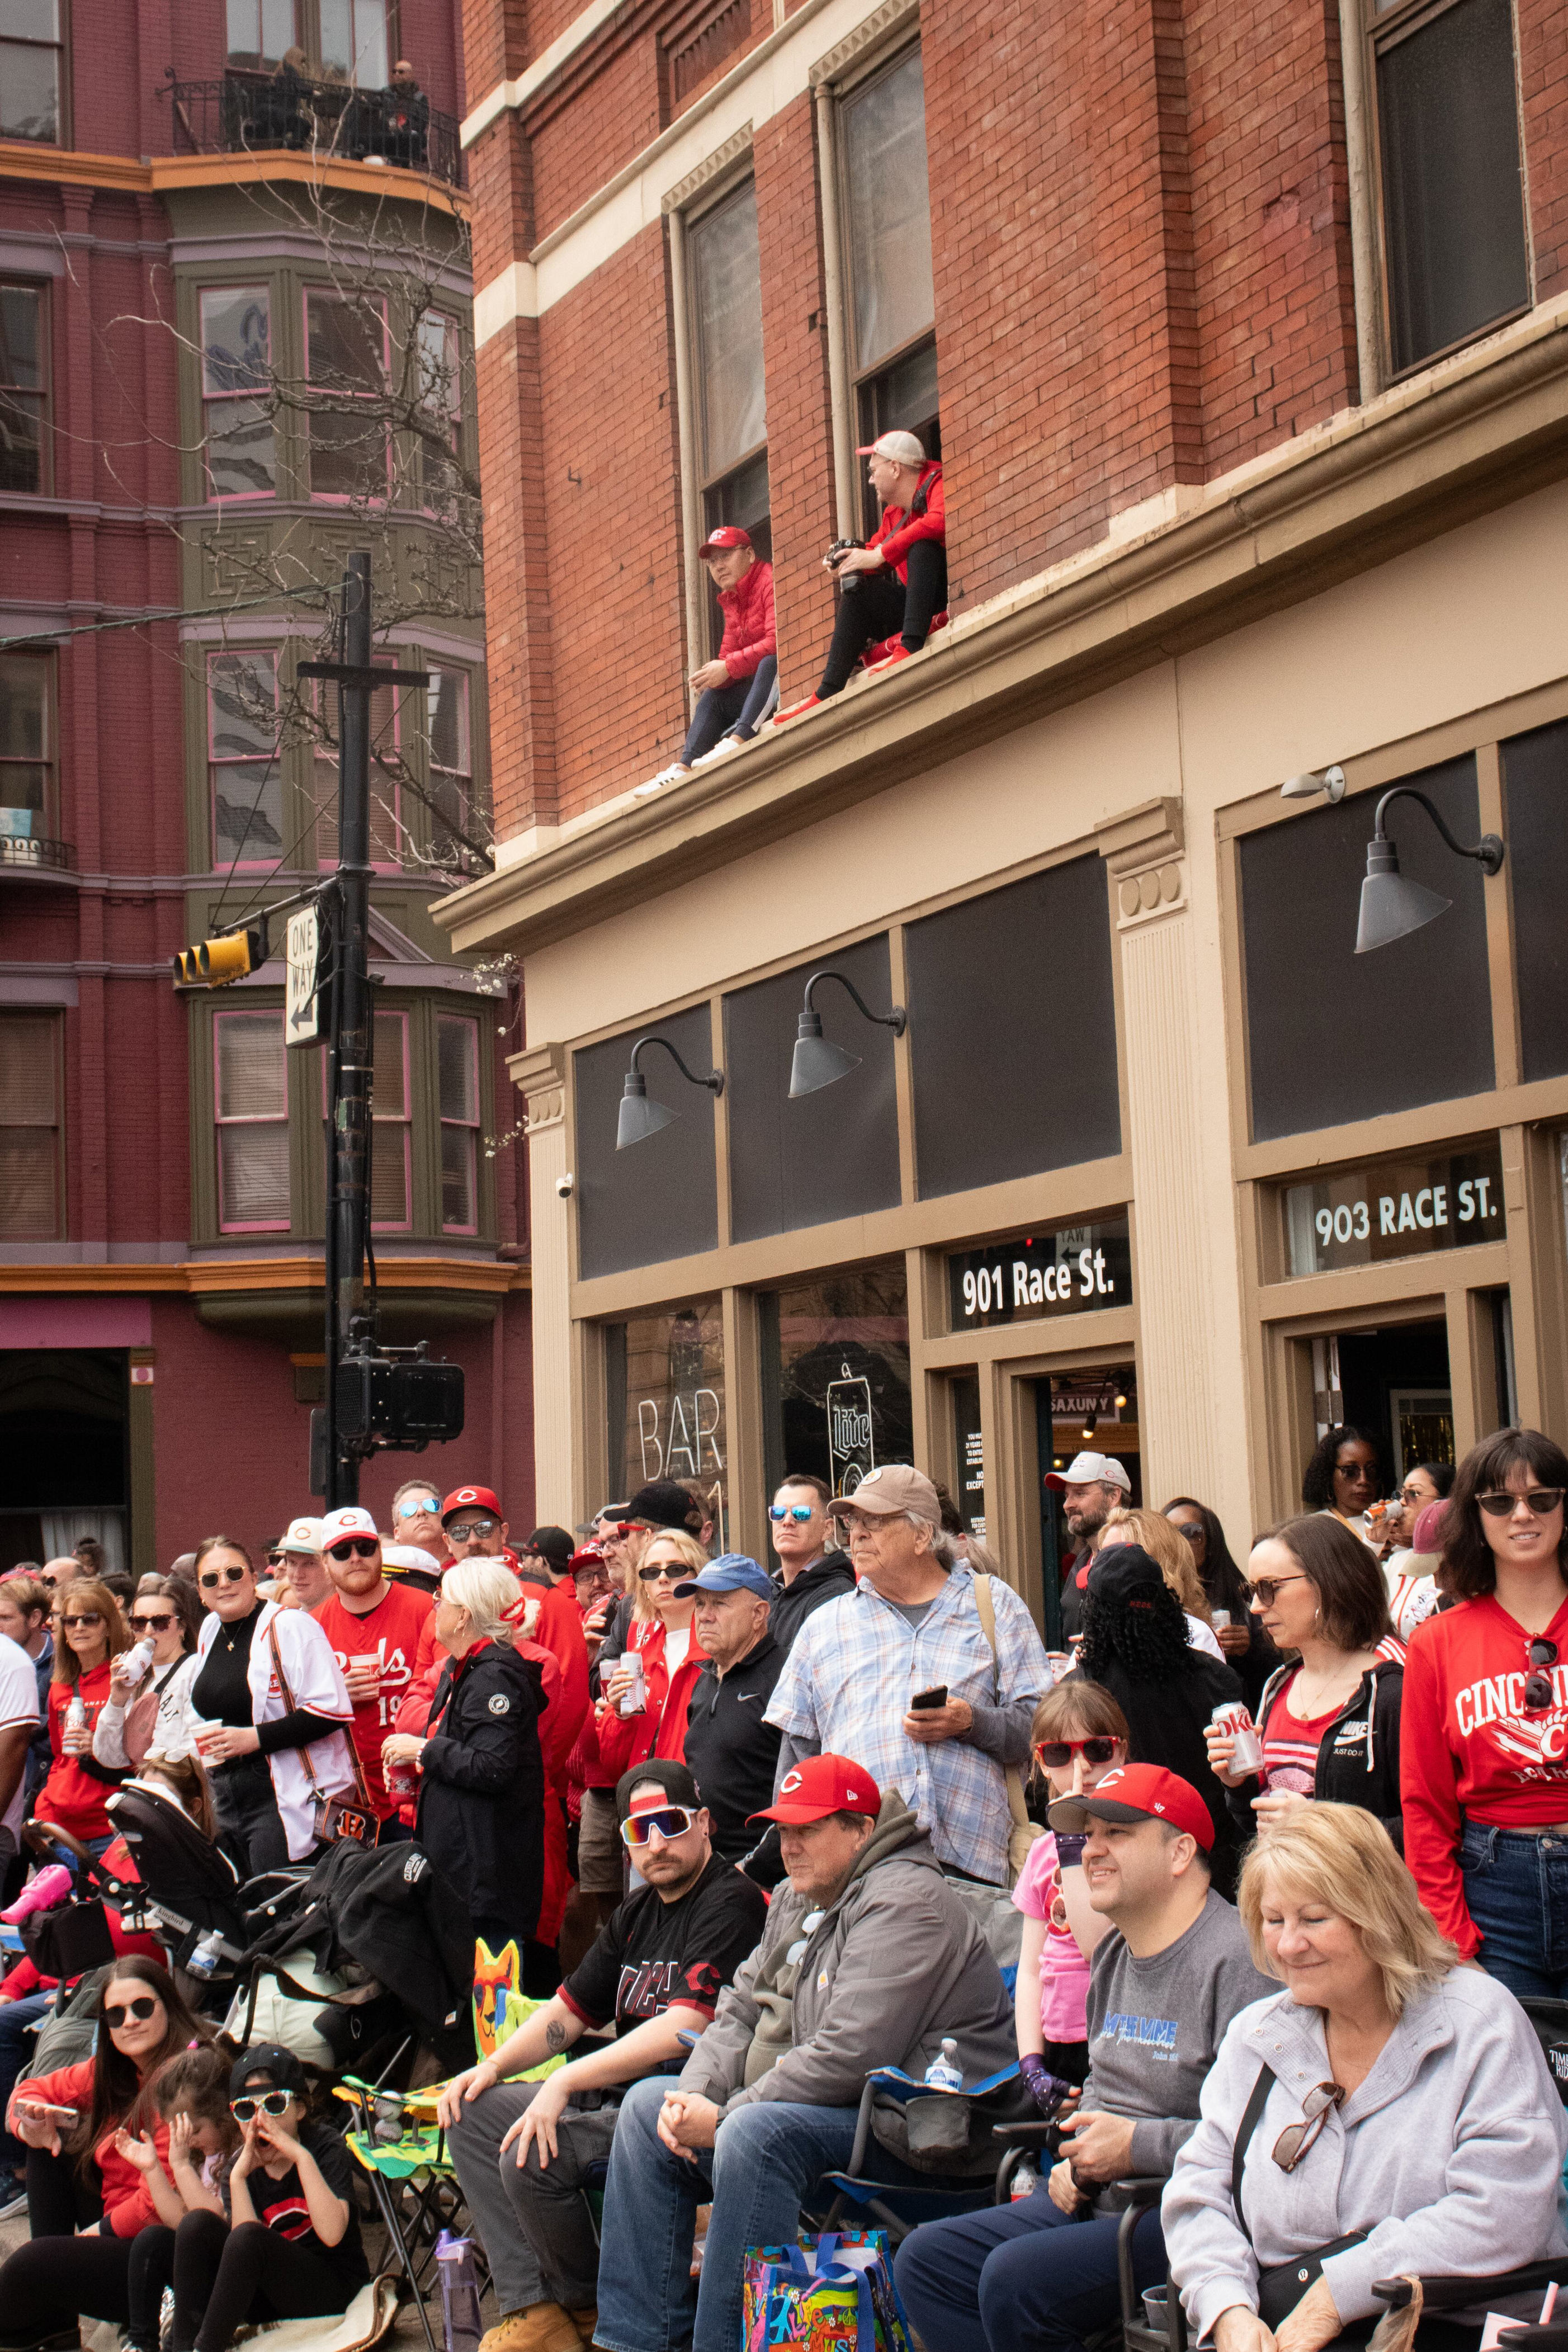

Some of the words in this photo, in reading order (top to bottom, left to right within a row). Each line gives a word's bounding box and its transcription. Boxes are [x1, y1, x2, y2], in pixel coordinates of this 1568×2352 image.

[292, 918, 313, 958] ONE
[292, 958, 313, 998] WAY
[1316, 1201, 1370, 1246] 903
[1379, 1185, 1448, 1236] RACE
[1458, 1177, 1498, 1222] ST.
[963, 1265, 1003, 1315] 901
[1013, 1261, 1071, 1306] Race
[1079, 1248, 1114, 1297] St.
[638, 1389, 724, 1482] BAR
[833, 1407, 870, 1461] Lite
[976, 1471, 984, 1480] NO
[158, 1907, 185, 1926] kingbird
[1140, 2016, 1178, 2044] VINE
[1153, 2049, 1168, 2061] John
